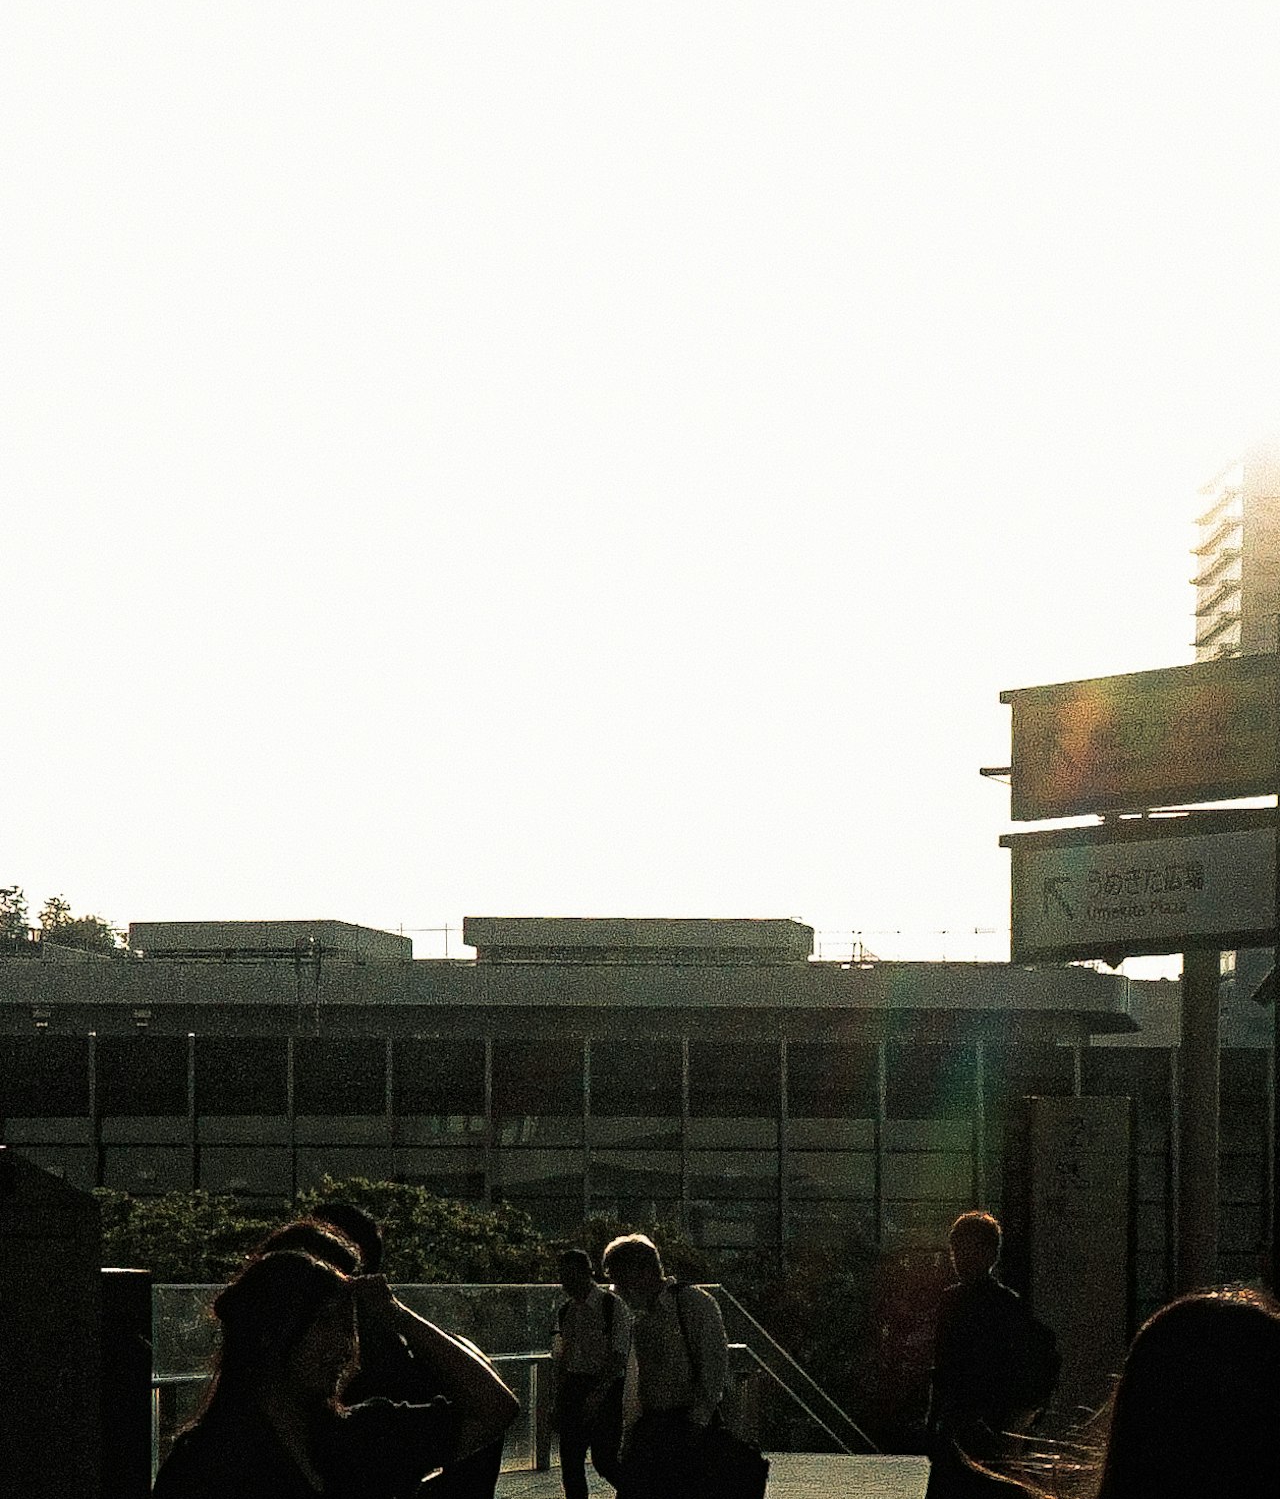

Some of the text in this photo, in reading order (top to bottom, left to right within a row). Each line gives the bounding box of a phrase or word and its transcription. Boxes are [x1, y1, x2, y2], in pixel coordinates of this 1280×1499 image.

[1088, 860, 1204, 898] うめきた広場
